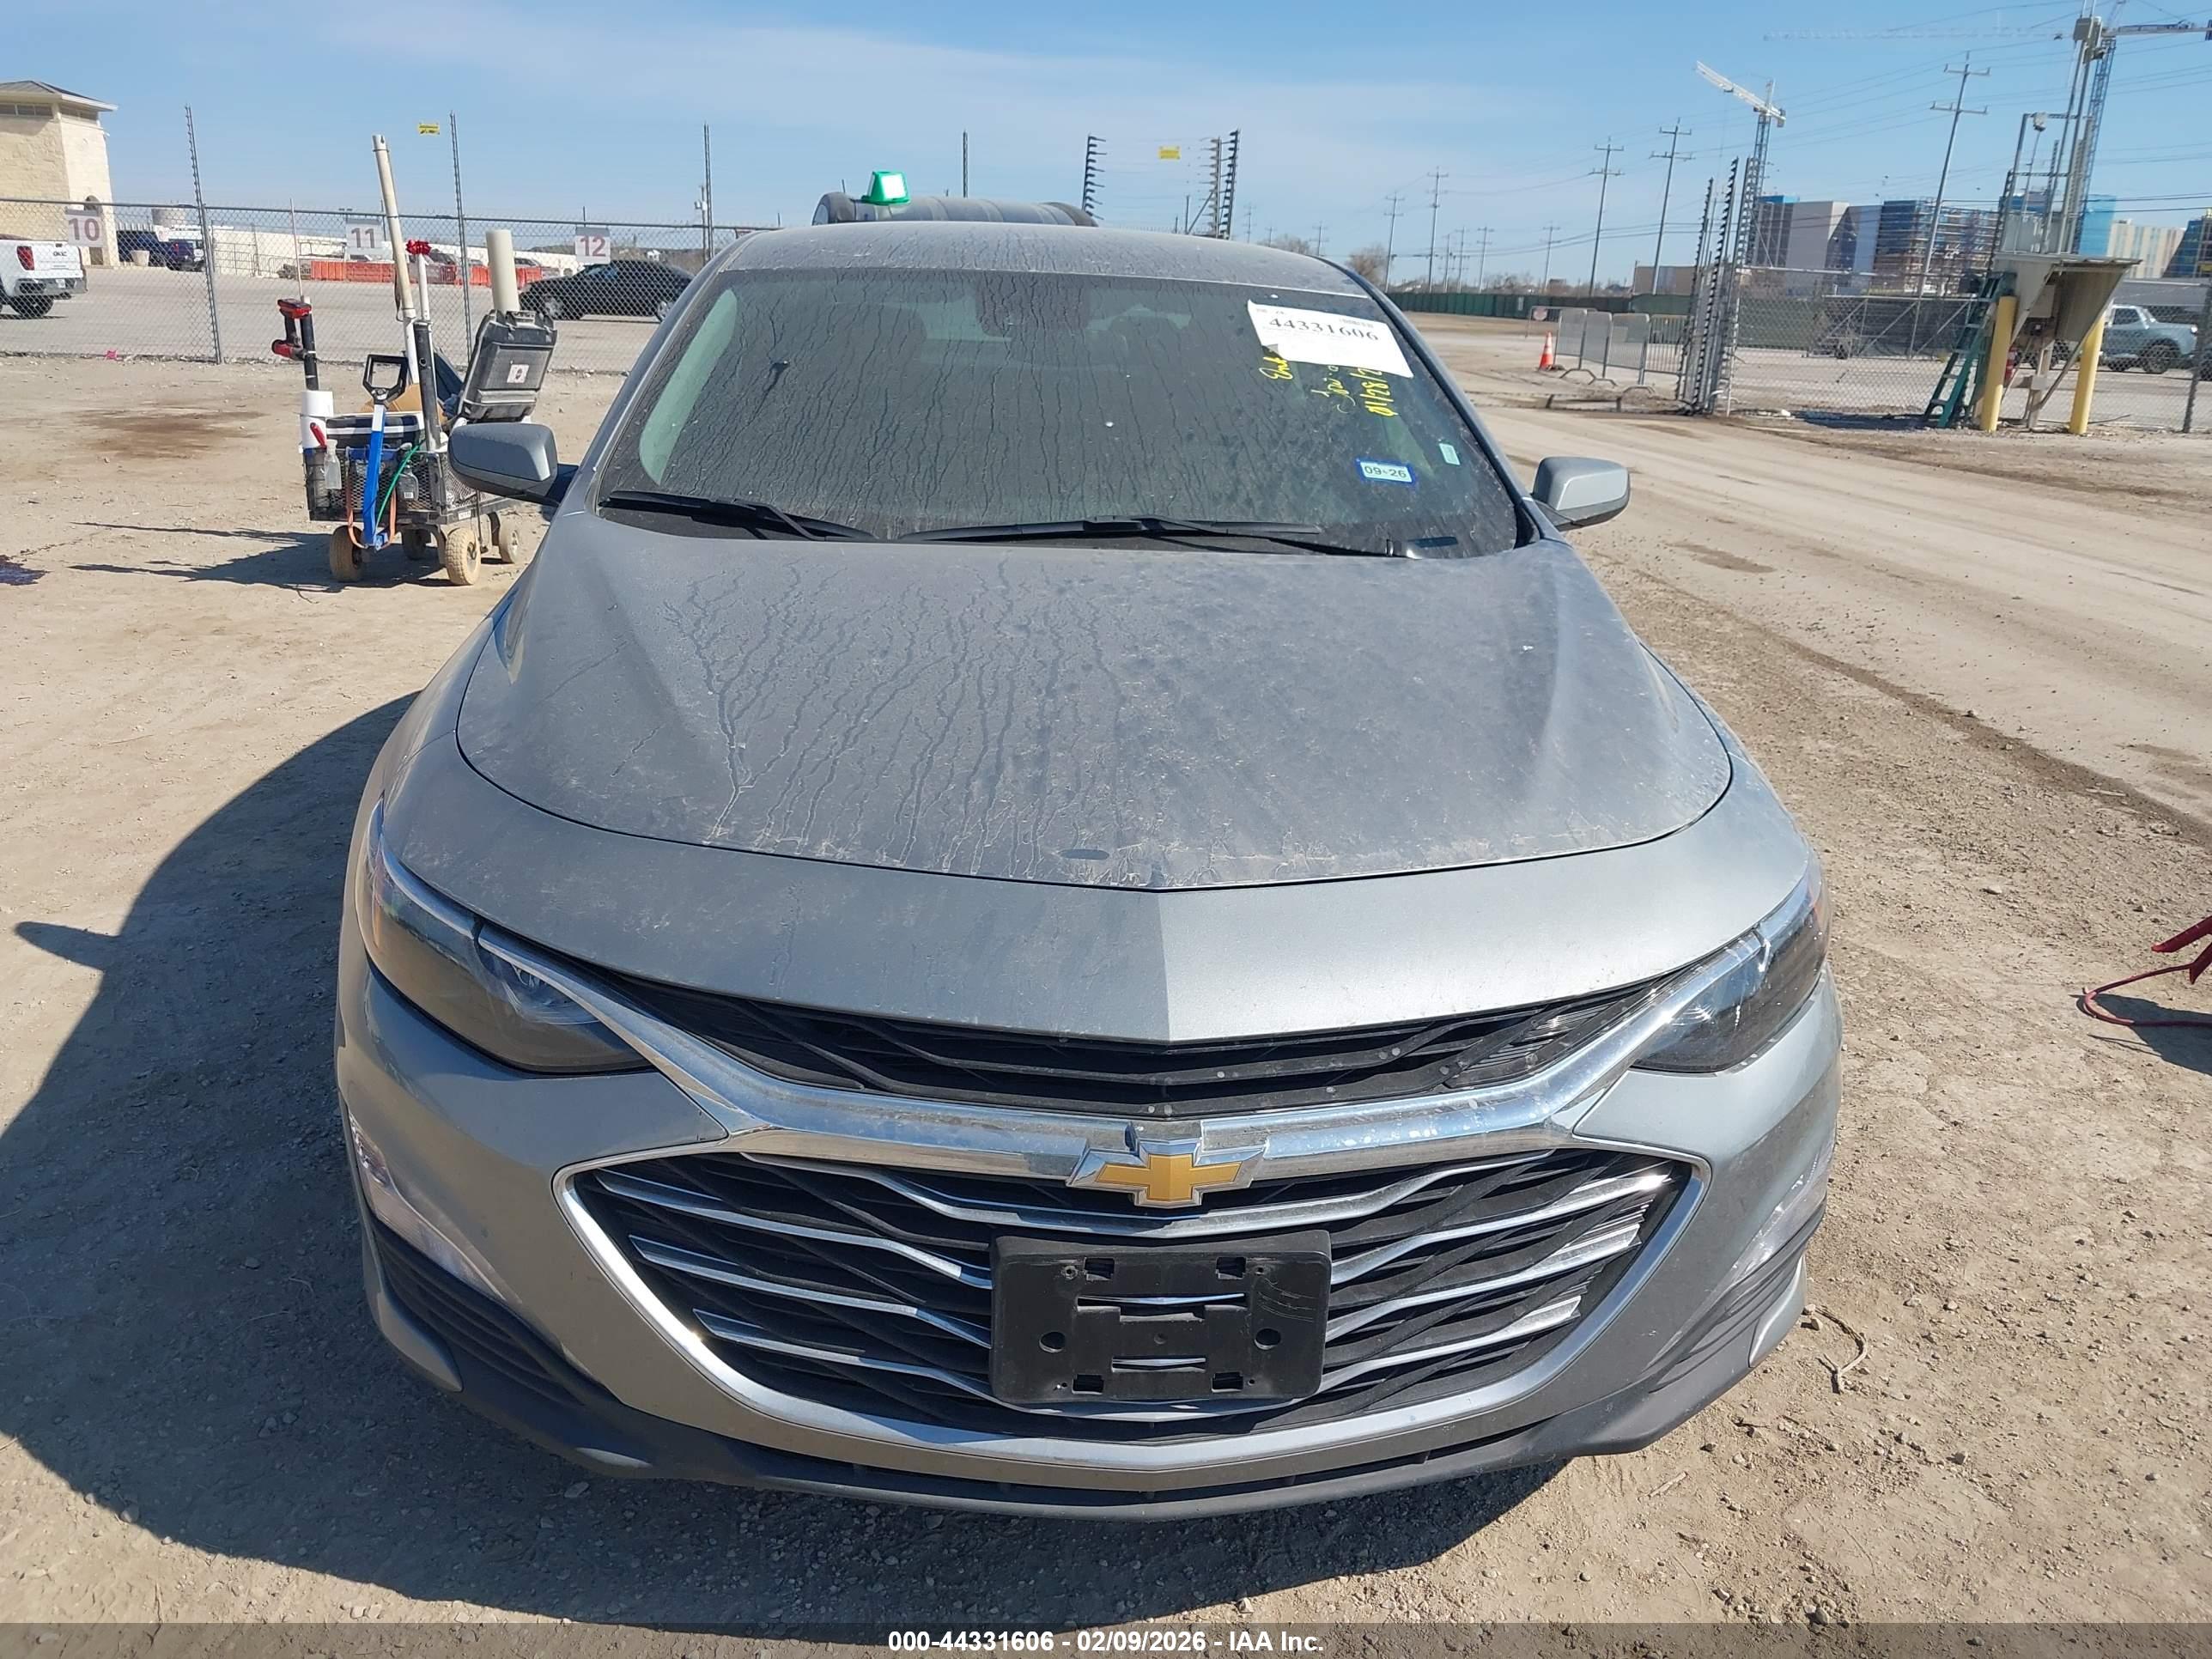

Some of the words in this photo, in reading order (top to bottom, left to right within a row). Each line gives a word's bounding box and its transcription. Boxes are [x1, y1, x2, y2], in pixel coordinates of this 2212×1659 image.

[69, 218, 100, 241] 10
[351, 228, 375, 248] 11
[580, 234, 606, 257] 12
[1269, 318, 1379, 341] 44331606
